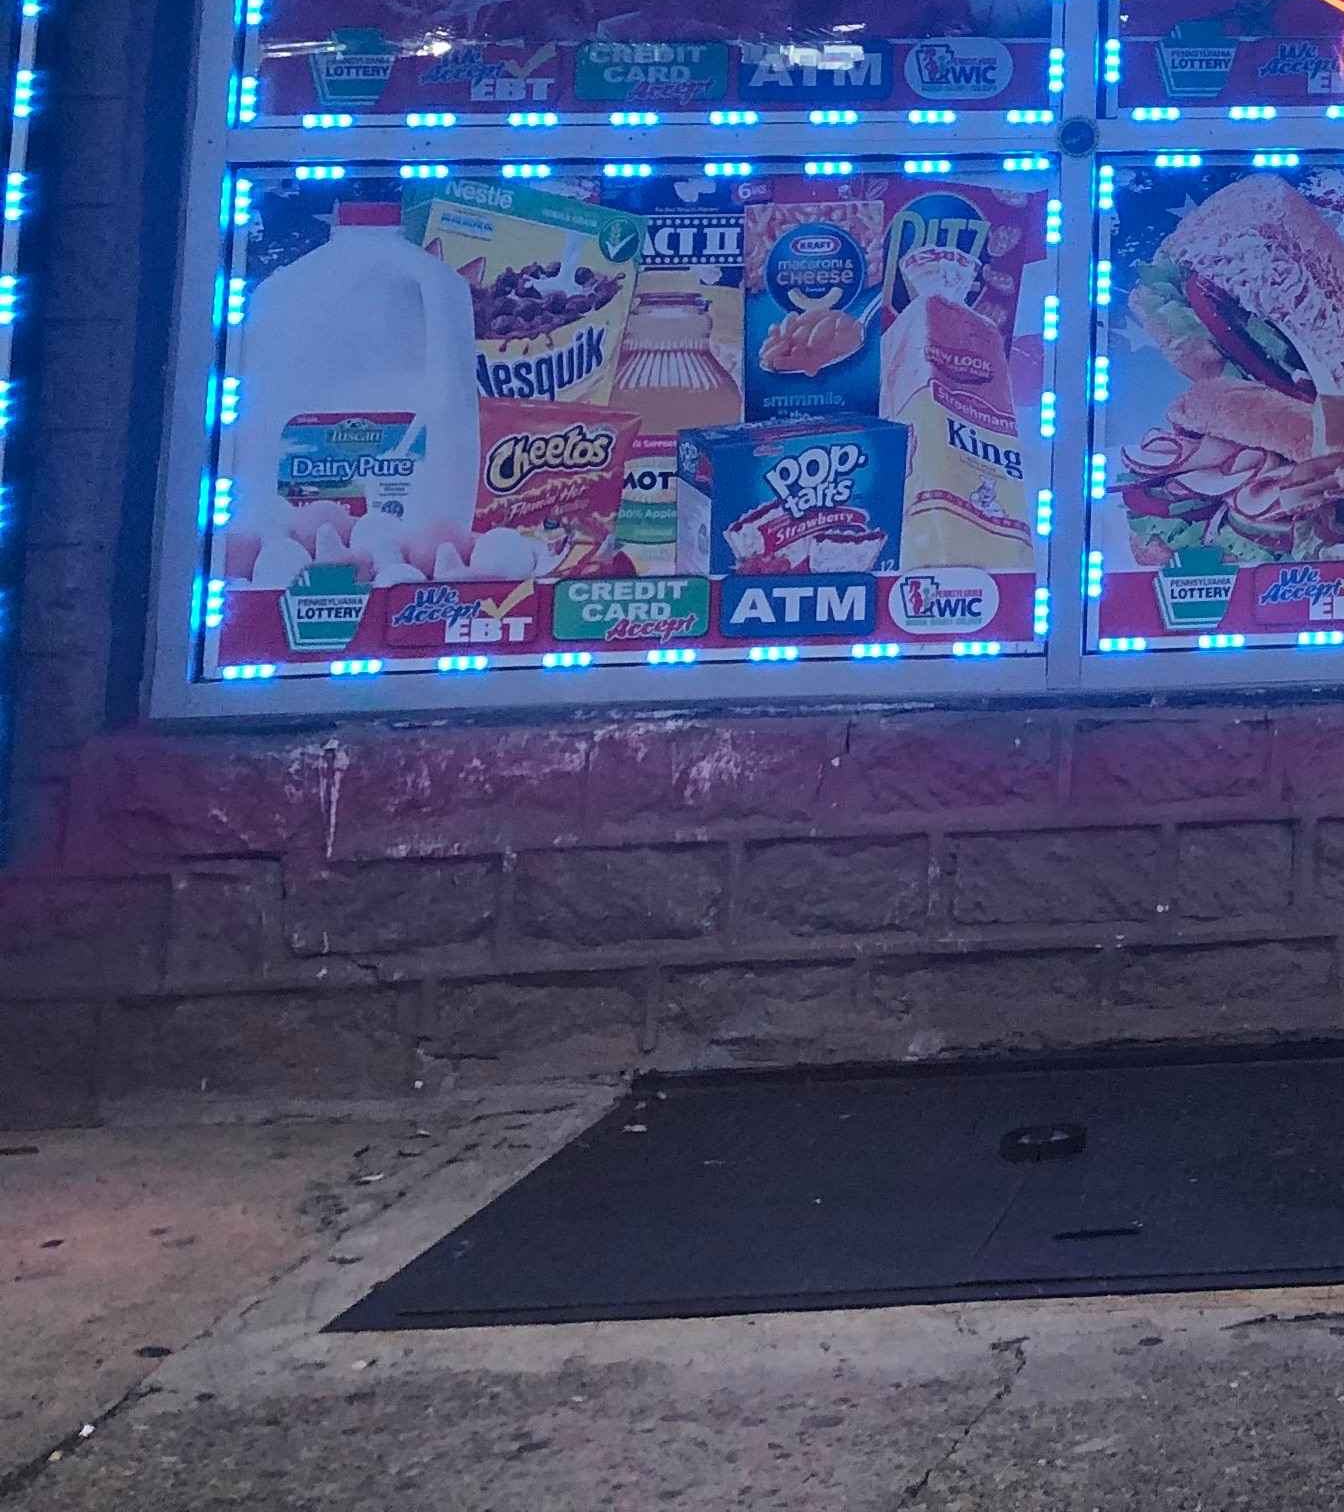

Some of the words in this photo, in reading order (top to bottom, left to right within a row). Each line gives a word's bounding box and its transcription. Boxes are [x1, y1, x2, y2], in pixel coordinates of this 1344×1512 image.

[589, 43, 706, 65] CREDIT
[1171, 58, 1231, 70] LOTTERY
[325, 65, 391, 78] LOTTERY
[602, 65, 690, 83] CARD
[748, 45, 882, 87] ATM
[951, 65, 997, 84] WIC
[470, 78, 555, 101] EBT
[738, 183, 752, 199] 6
[643, 227, 698, 256] ACT
[799, 240, 832, 250] KRAFT
[777, 258, 842, 270] macaroni
[954, 355, 992, 372] LOOK
[487, 424, 618, 493] Cheetos
[946, 417, 1024, 480] King
[784, 479, 853, 519] tarts
[775, 511, 854, 545] Strawberry
[879, 558, 895, 572] 12
[1279, 565, 1321, 587] We
[415, 585, 459, 609] We
[567, 580, 689, 602] CREDIT
[1169, 586, 1231, 600] LOTTERY
[1259, 578, 1343, 606] Accept
[296, 606, 363, 620] LOTTERY
[392, 599, 482, 627] Accept
[582, 601, 671, 623] CARD
[729, 584, 867, 625] ATM
[935, 597, 984, 618] WIC
[444, 616, 533, 644] EBT
[604, 613, 697, 644] Accept
